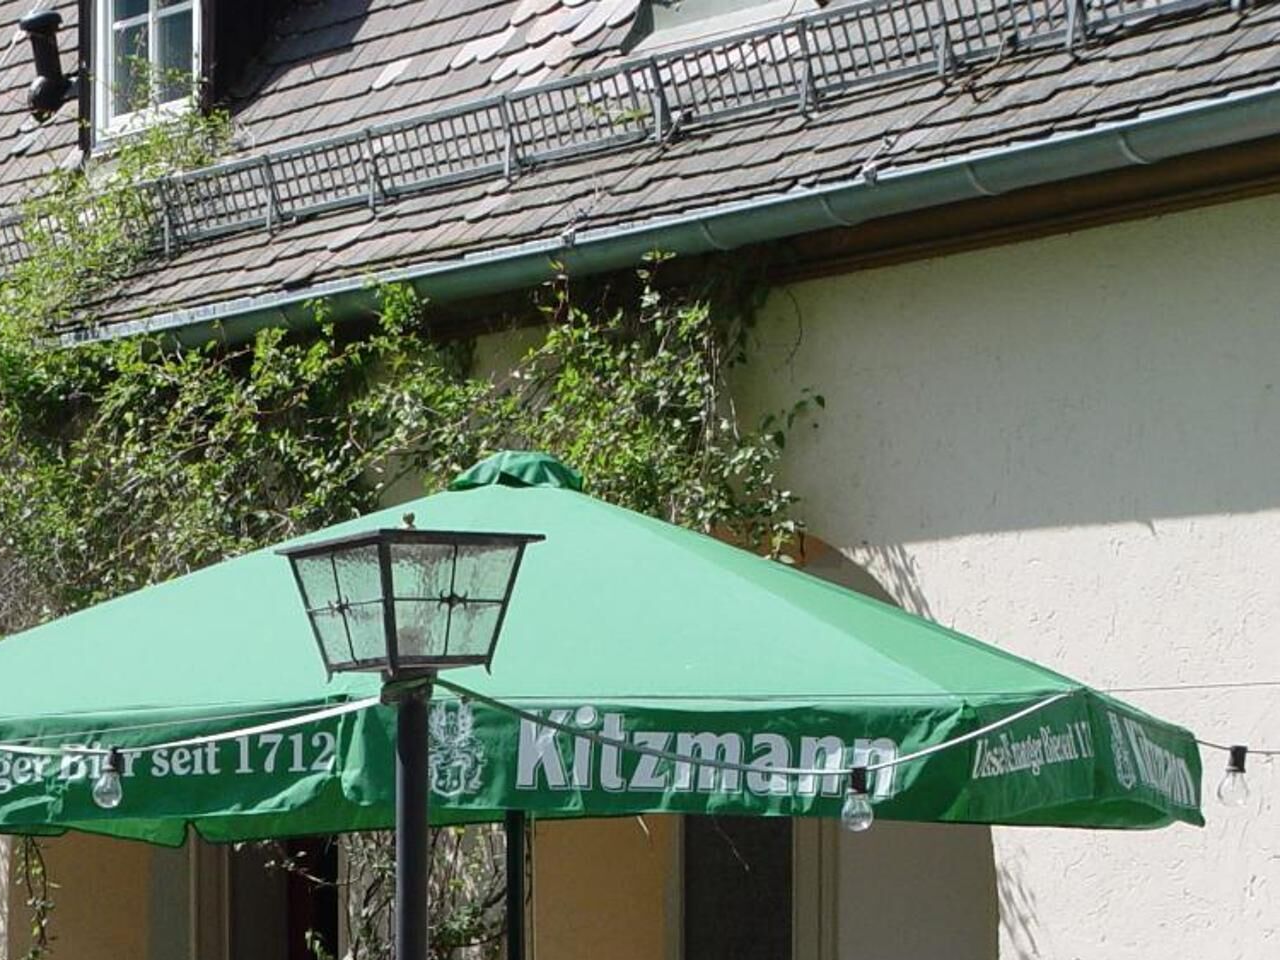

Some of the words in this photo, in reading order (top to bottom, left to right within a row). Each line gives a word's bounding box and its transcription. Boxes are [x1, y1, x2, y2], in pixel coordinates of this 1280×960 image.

[57, 743, 142, 779] Bir
[151, 736, 221, 777] seit
[233, 732, 336, 774] 1712
[516, 706, 899, 799] Kitzmann
